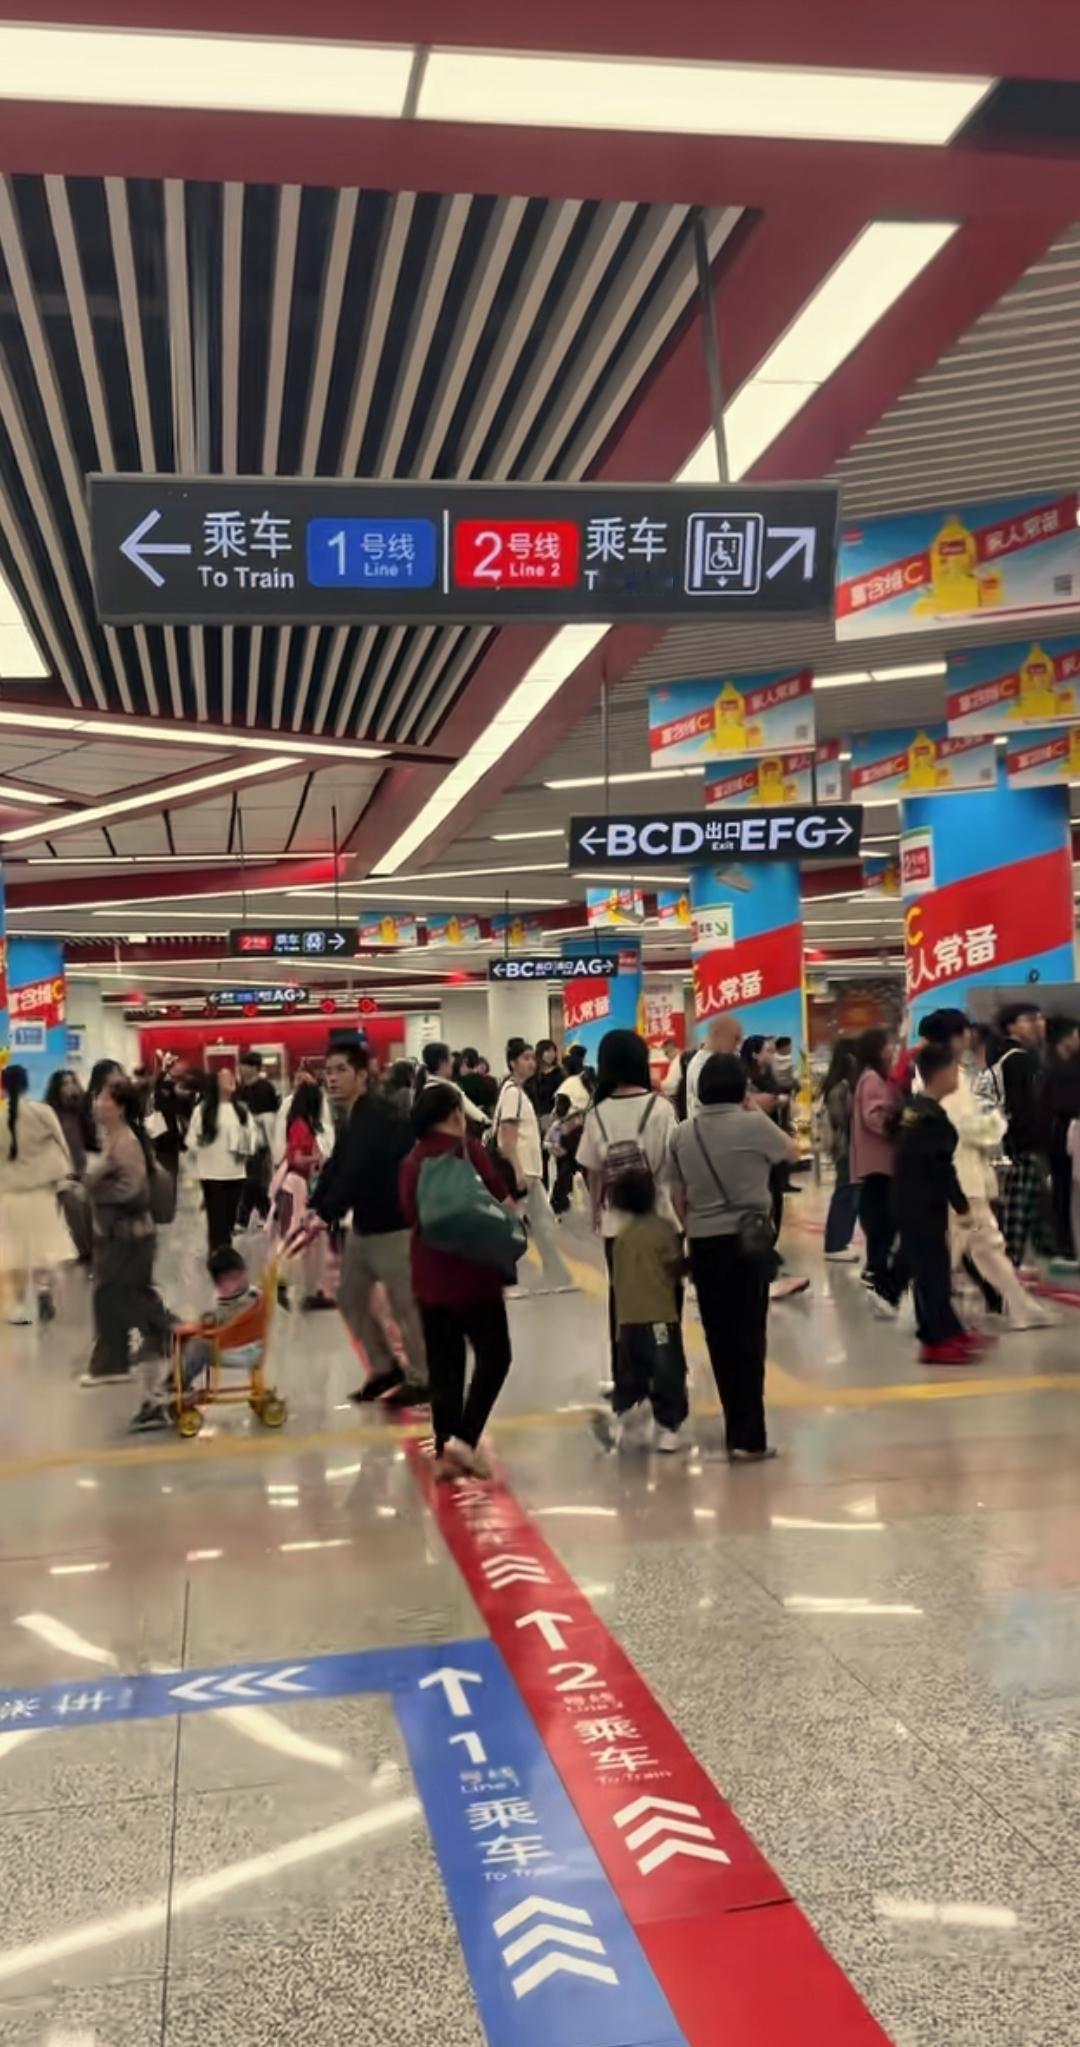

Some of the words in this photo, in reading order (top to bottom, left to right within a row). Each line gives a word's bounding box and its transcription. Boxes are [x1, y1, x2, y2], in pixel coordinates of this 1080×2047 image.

[203, 510, 292, 558] 乘车
[585, 517, 668, 562] 乘车
[197, 566, 229, 587] To
[234, 567, 295, 589] Train
[364, 563, 398, 577] Line
[406, 563, 413, 576] 1
[509, 562, 544, 577] Line
[551, 562, 561, 577] 2
[705, 822, 741, 839] 出口
[506, 962, 534, 977] BC
[574, 959, 601, 974] AG
[274, 989, 296, 1001] AG
[548, 1662, 607, 1691] 2
[448, 1731, 487, 1764] 1
